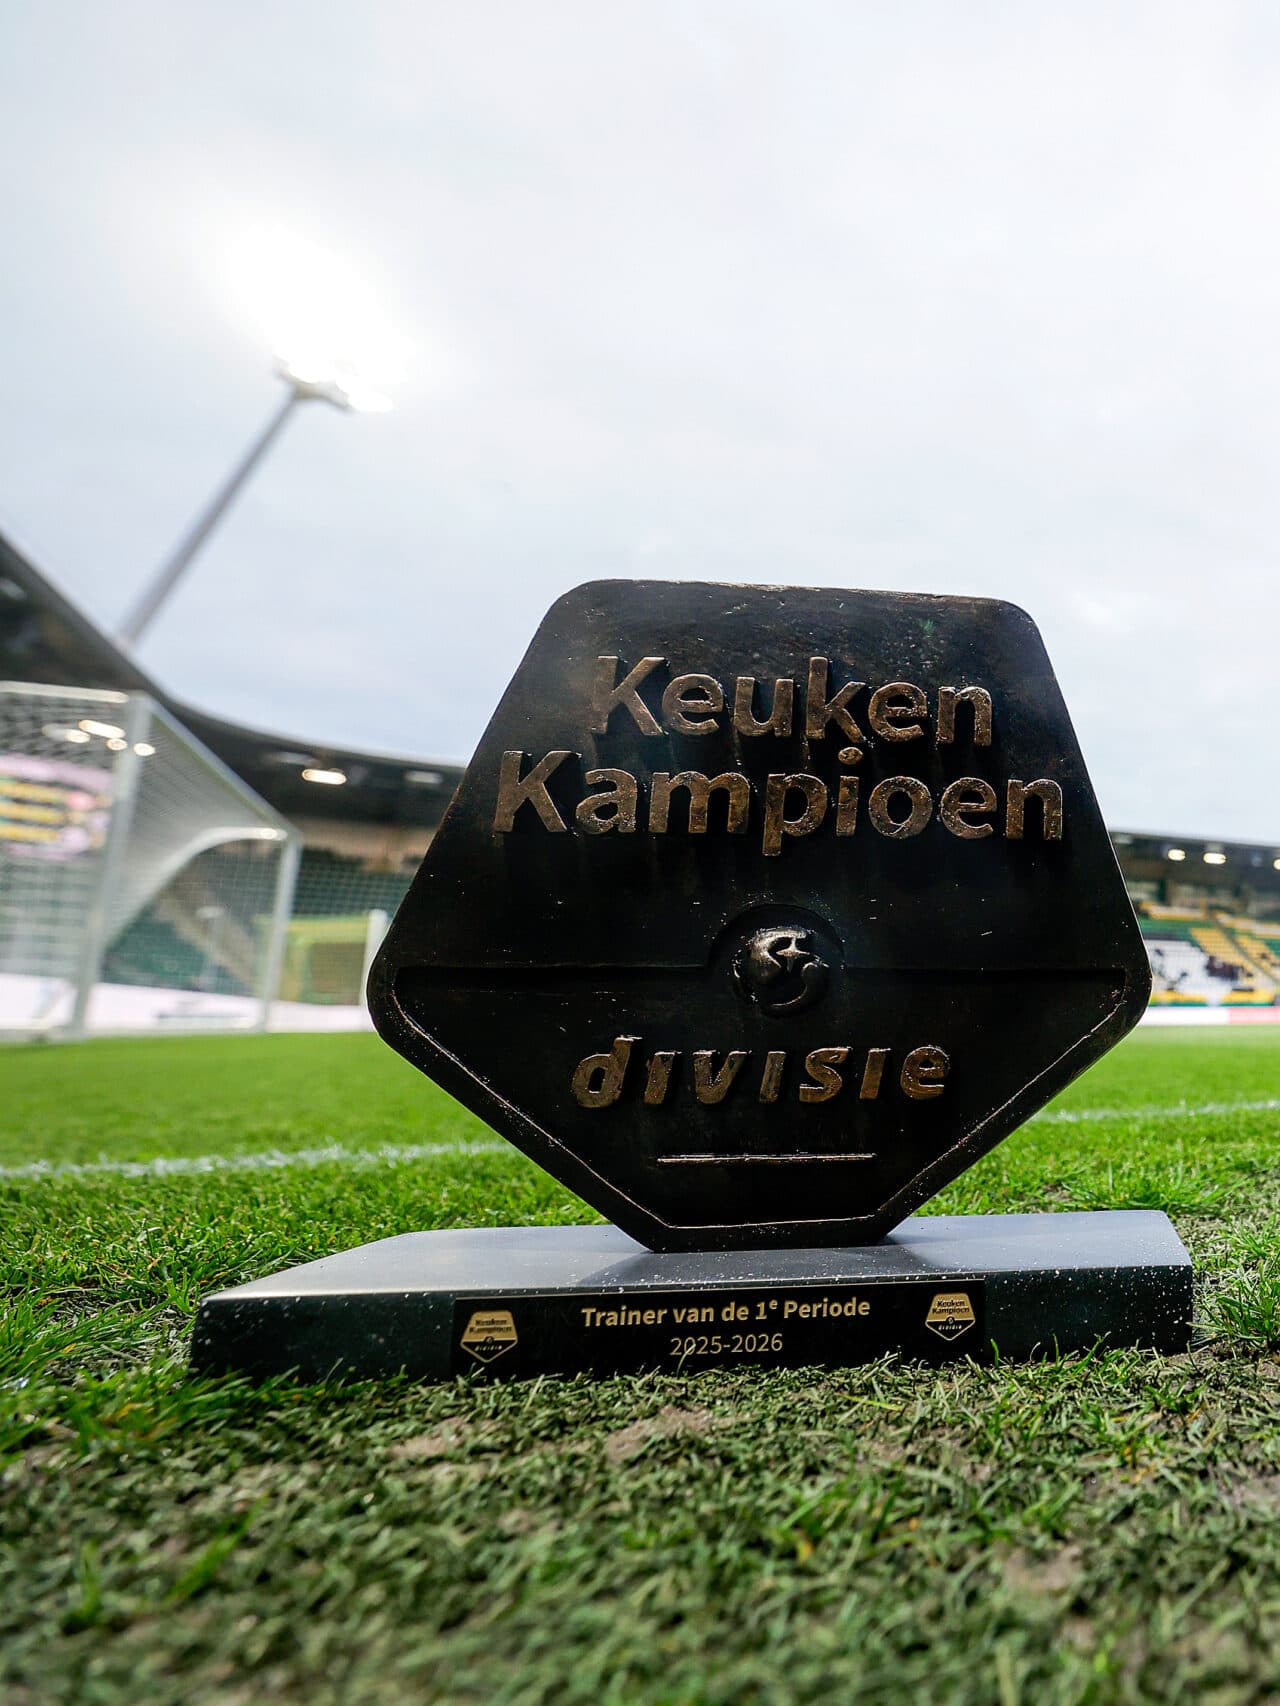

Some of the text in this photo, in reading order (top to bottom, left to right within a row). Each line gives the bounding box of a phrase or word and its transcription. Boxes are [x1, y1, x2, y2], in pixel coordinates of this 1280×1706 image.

[592, 655, 993, 747] Keuken
[494, 746, 1064, 857] Kampioen
[572, 1034, 950, 1108] divisie
[581, 1305, 667, 1327] Trainer
[673, 1308, 714, 1324] van
[721, 1302, 749, 1322] de
[783, 1297, 870, 1318] Periode
[669, 1333, 783, 1356] 2025-2026
